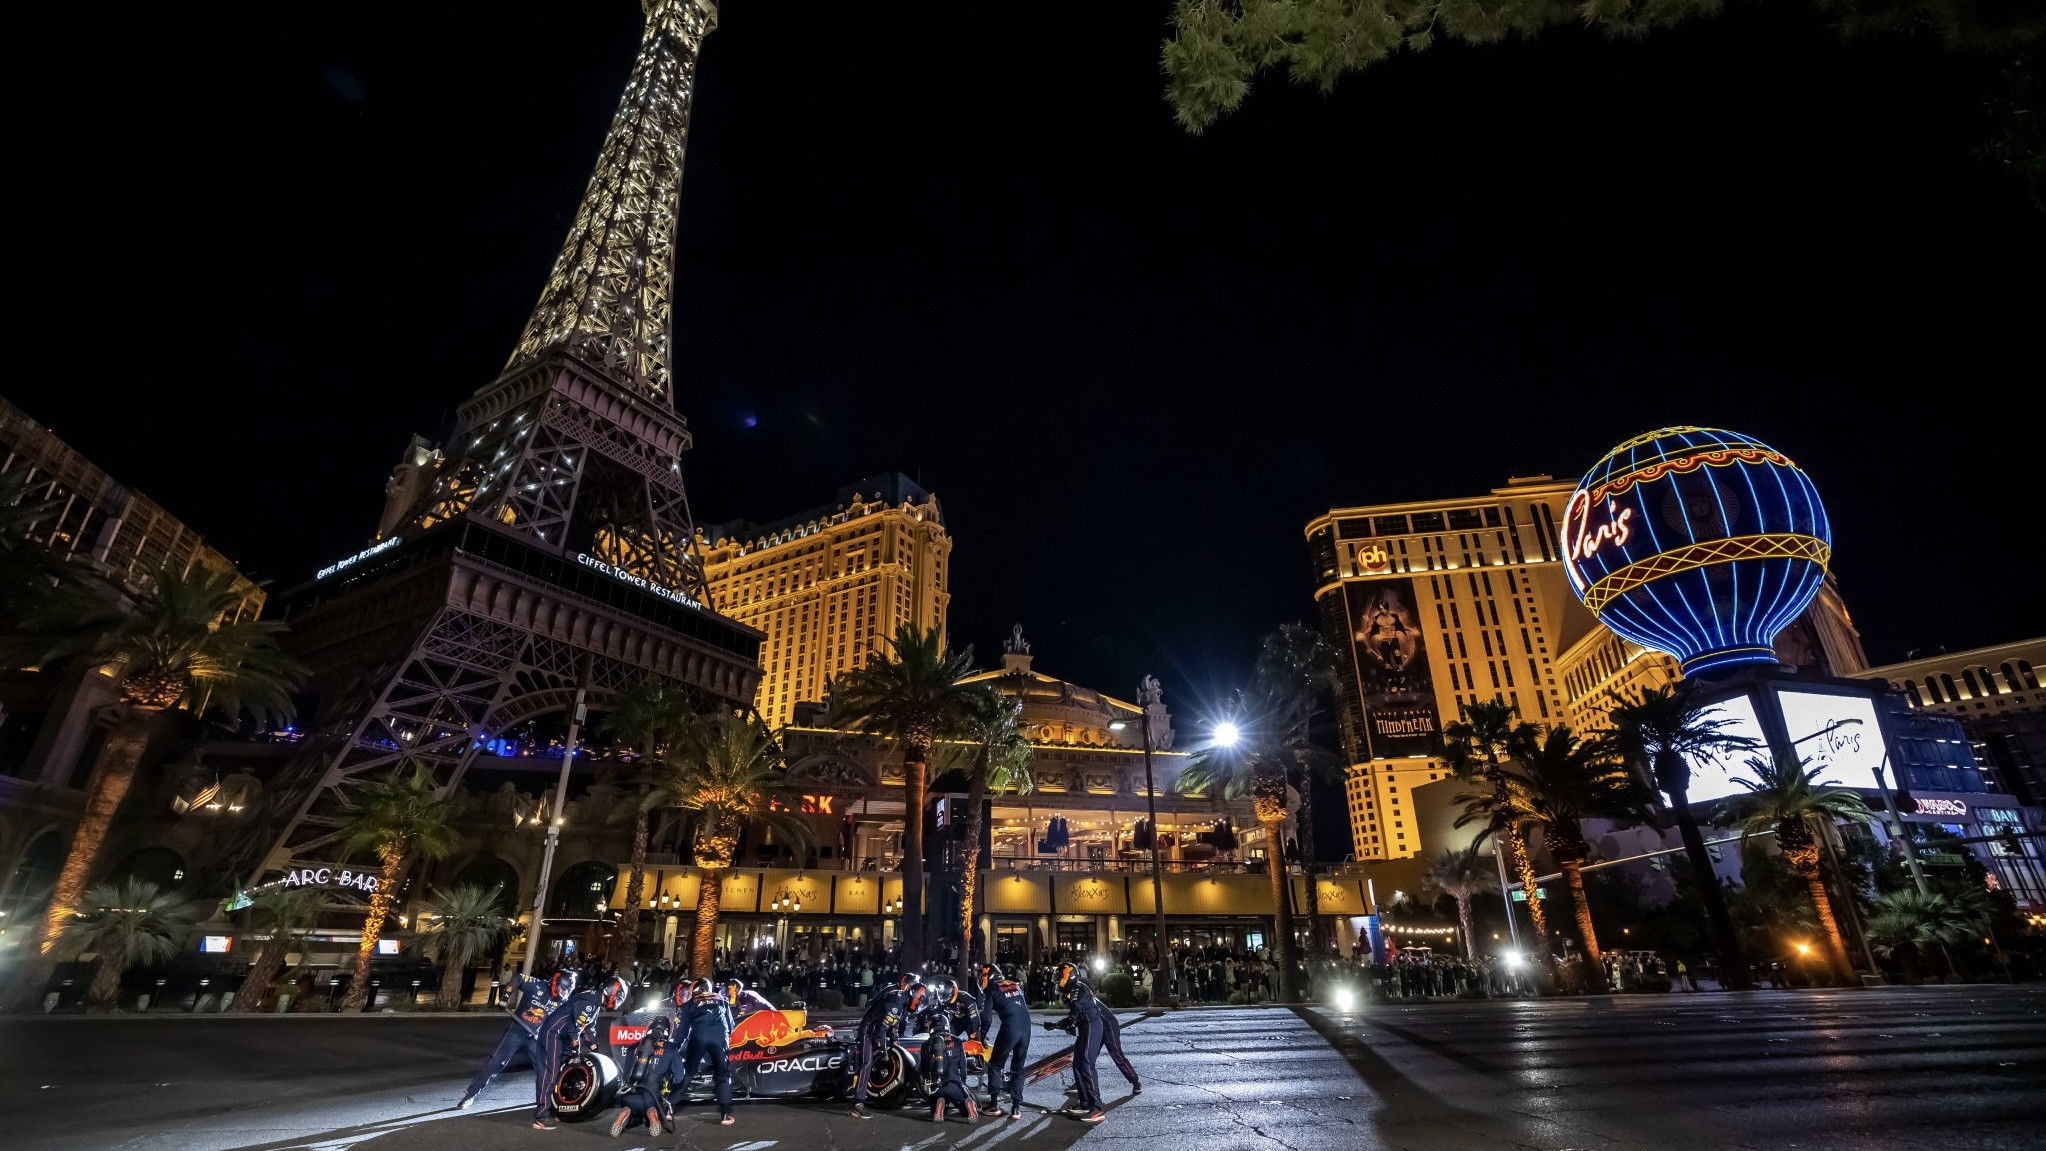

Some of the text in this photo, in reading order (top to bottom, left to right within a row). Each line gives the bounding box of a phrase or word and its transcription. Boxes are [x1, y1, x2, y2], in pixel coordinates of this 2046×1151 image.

[1561, 488, 1632, 590] Paris
[1362, 545, 1387, 567] ph
[577, 553, 703, 611] EIFFEL TOWER RESTAURANT
[1826, 718, 1861, 753] Paris
[285, 868, 378, 893] ARC BAR
[728, 1050, 743, 1061] ed
[756, 1056, 843, 1074] ORACLE
